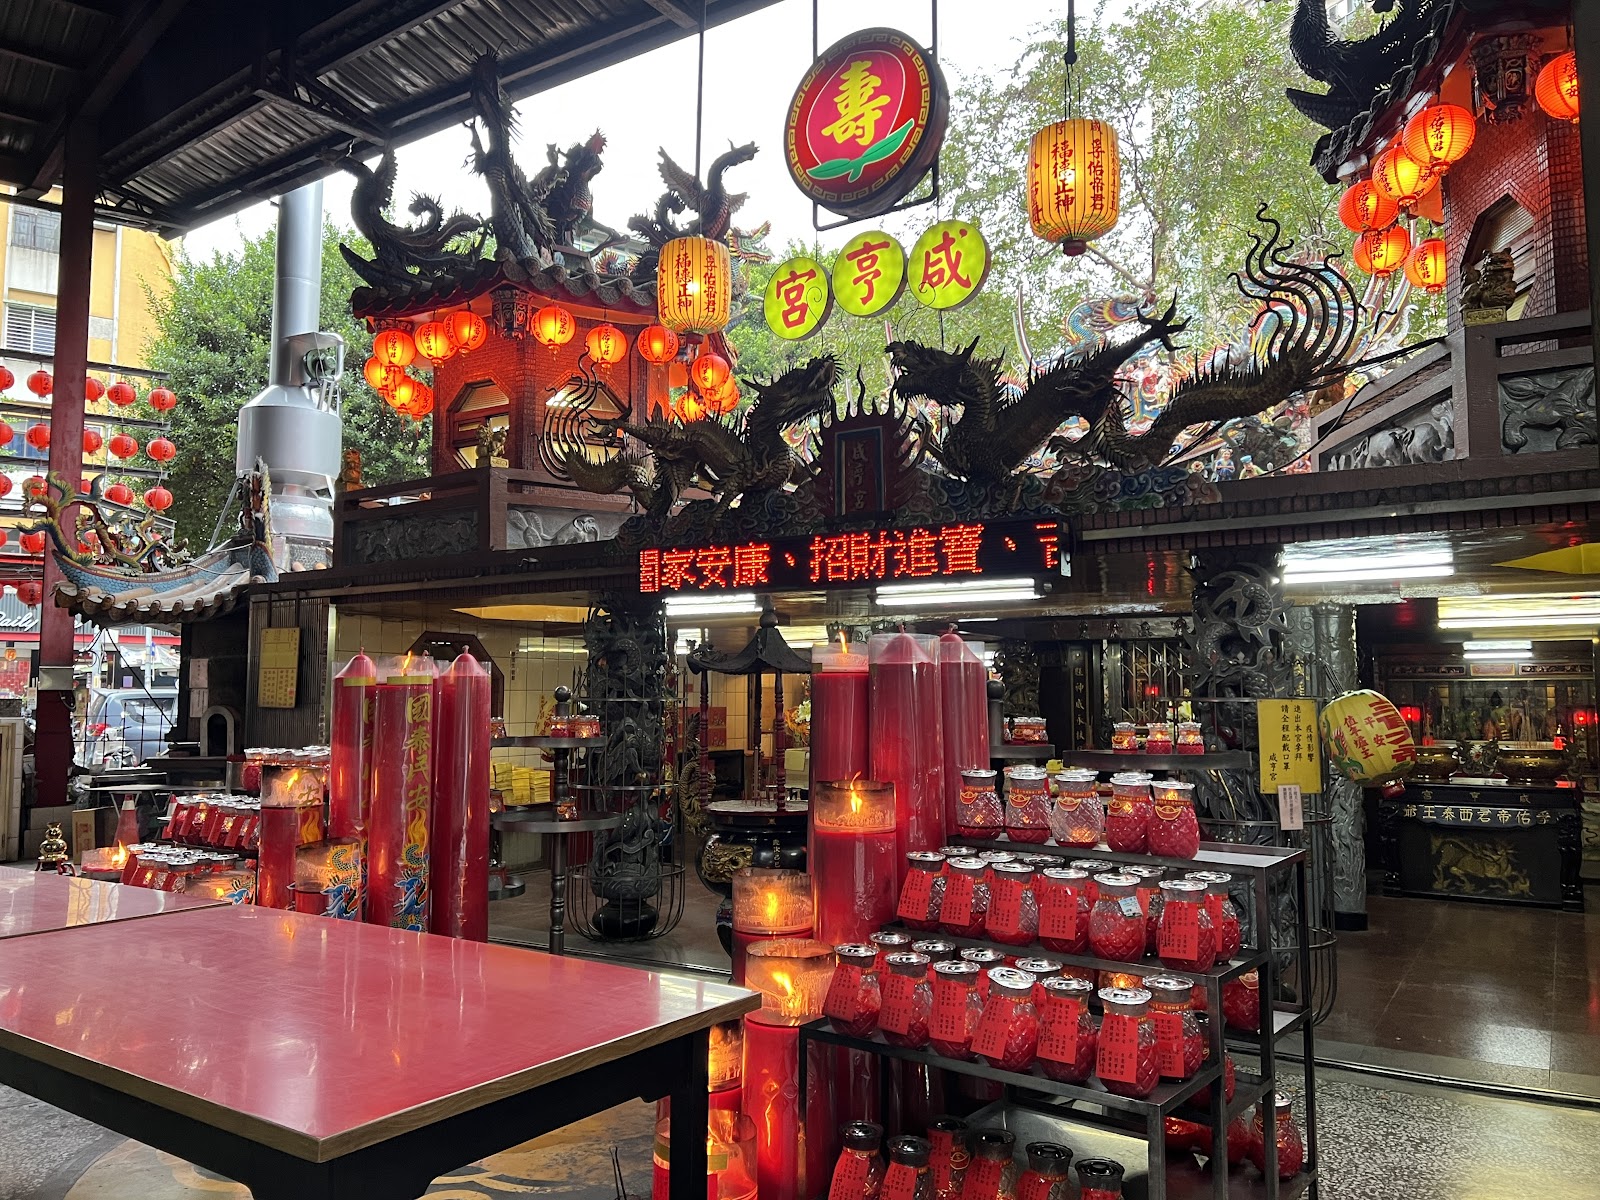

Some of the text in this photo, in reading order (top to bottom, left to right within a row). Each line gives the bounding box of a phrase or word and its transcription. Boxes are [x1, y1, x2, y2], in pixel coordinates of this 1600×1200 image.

[821, 61, 891, 146] 壽
[1051, 139, 1076, 213] 福德正神
[777, 228, 972, 329] 咸亨宮
[0, 611, 40, 632] aily
[405, 692, 431, 812] 國泰民安
[1281, 704, 1291, 771] 請全程配戴口罩
[1293, 704, 1303, 761] 進出本宮參拜
[1306, 725, 1315, 762] 疫情影響
[1364, 716, 1387, 748] 平安
[1268, 753, 1278, 781] 咸亨宮
